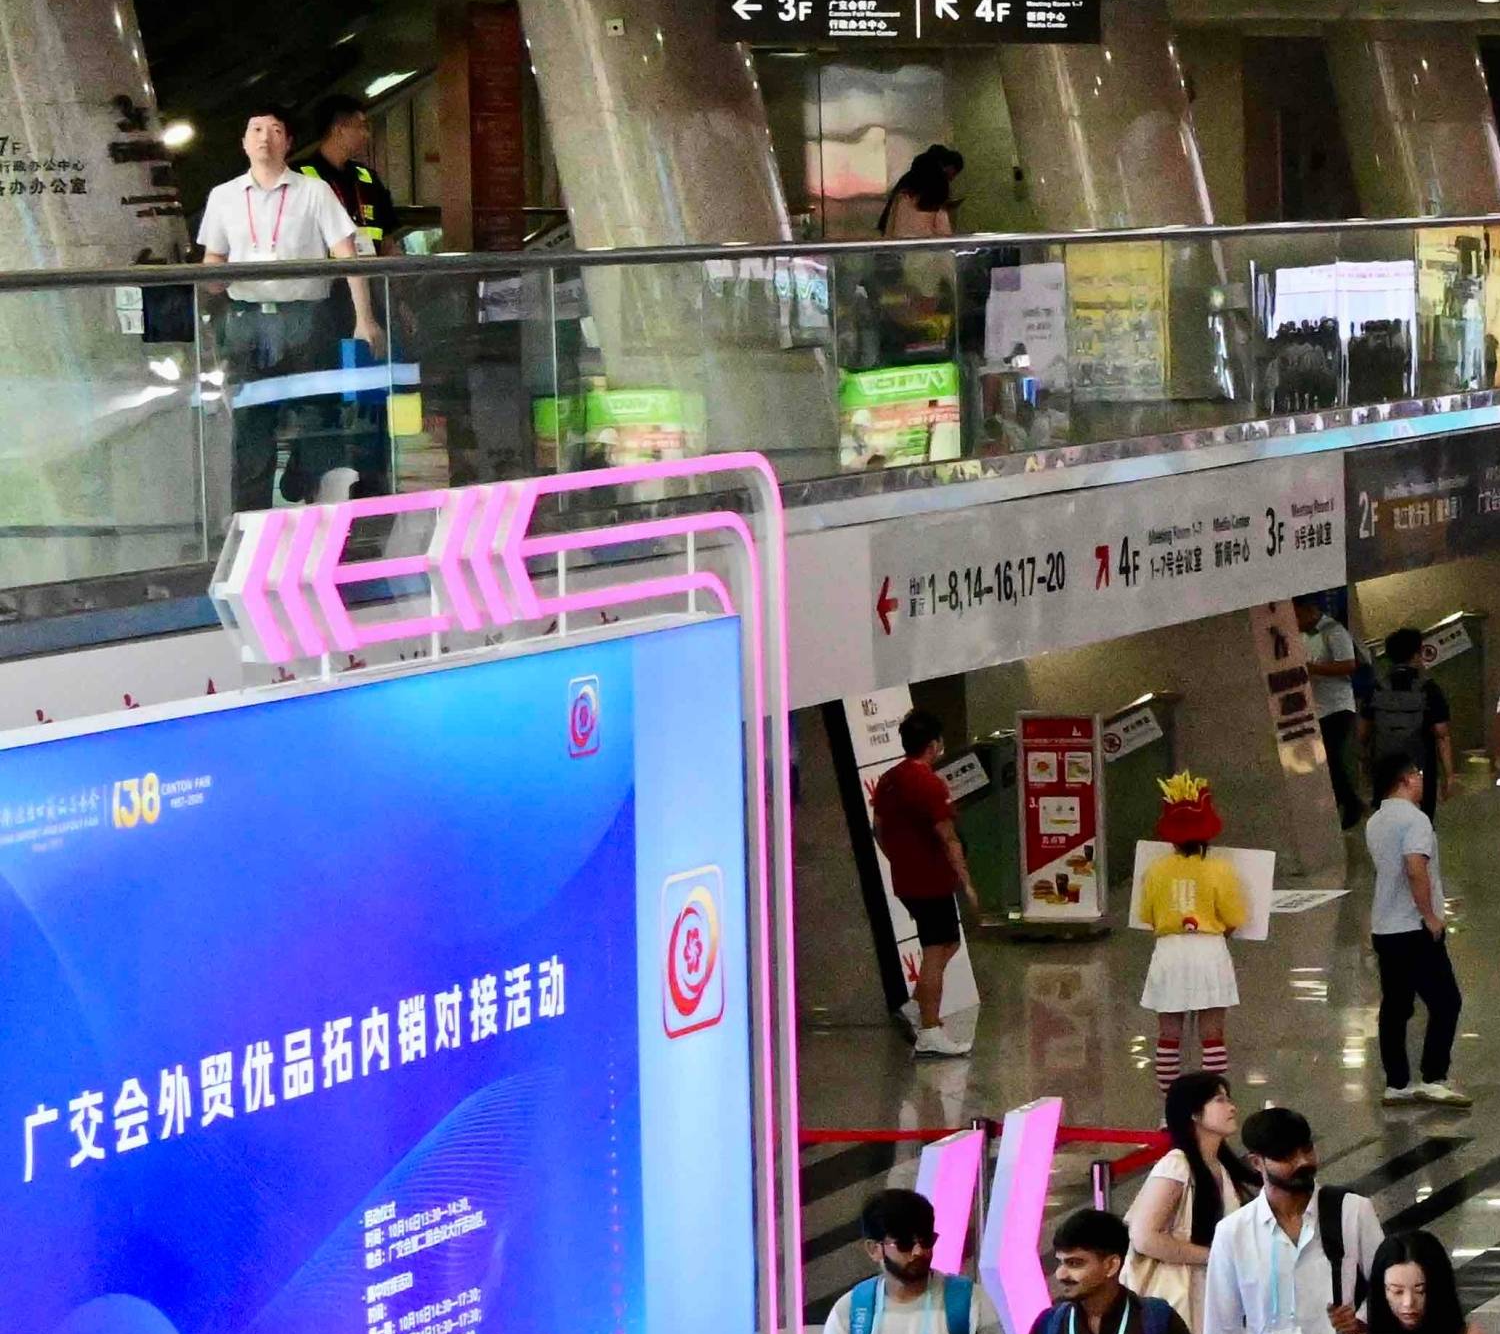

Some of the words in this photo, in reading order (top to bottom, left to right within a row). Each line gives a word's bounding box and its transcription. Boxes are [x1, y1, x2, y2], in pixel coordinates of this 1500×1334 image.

[1266, 507, 1285, 558] 3F
[1118, 536, 1141, 588] 4F
[112, 771, 161, 829] 138
[22, 954, 567, 1184] 广交会外贸优品拓内销对接活动
